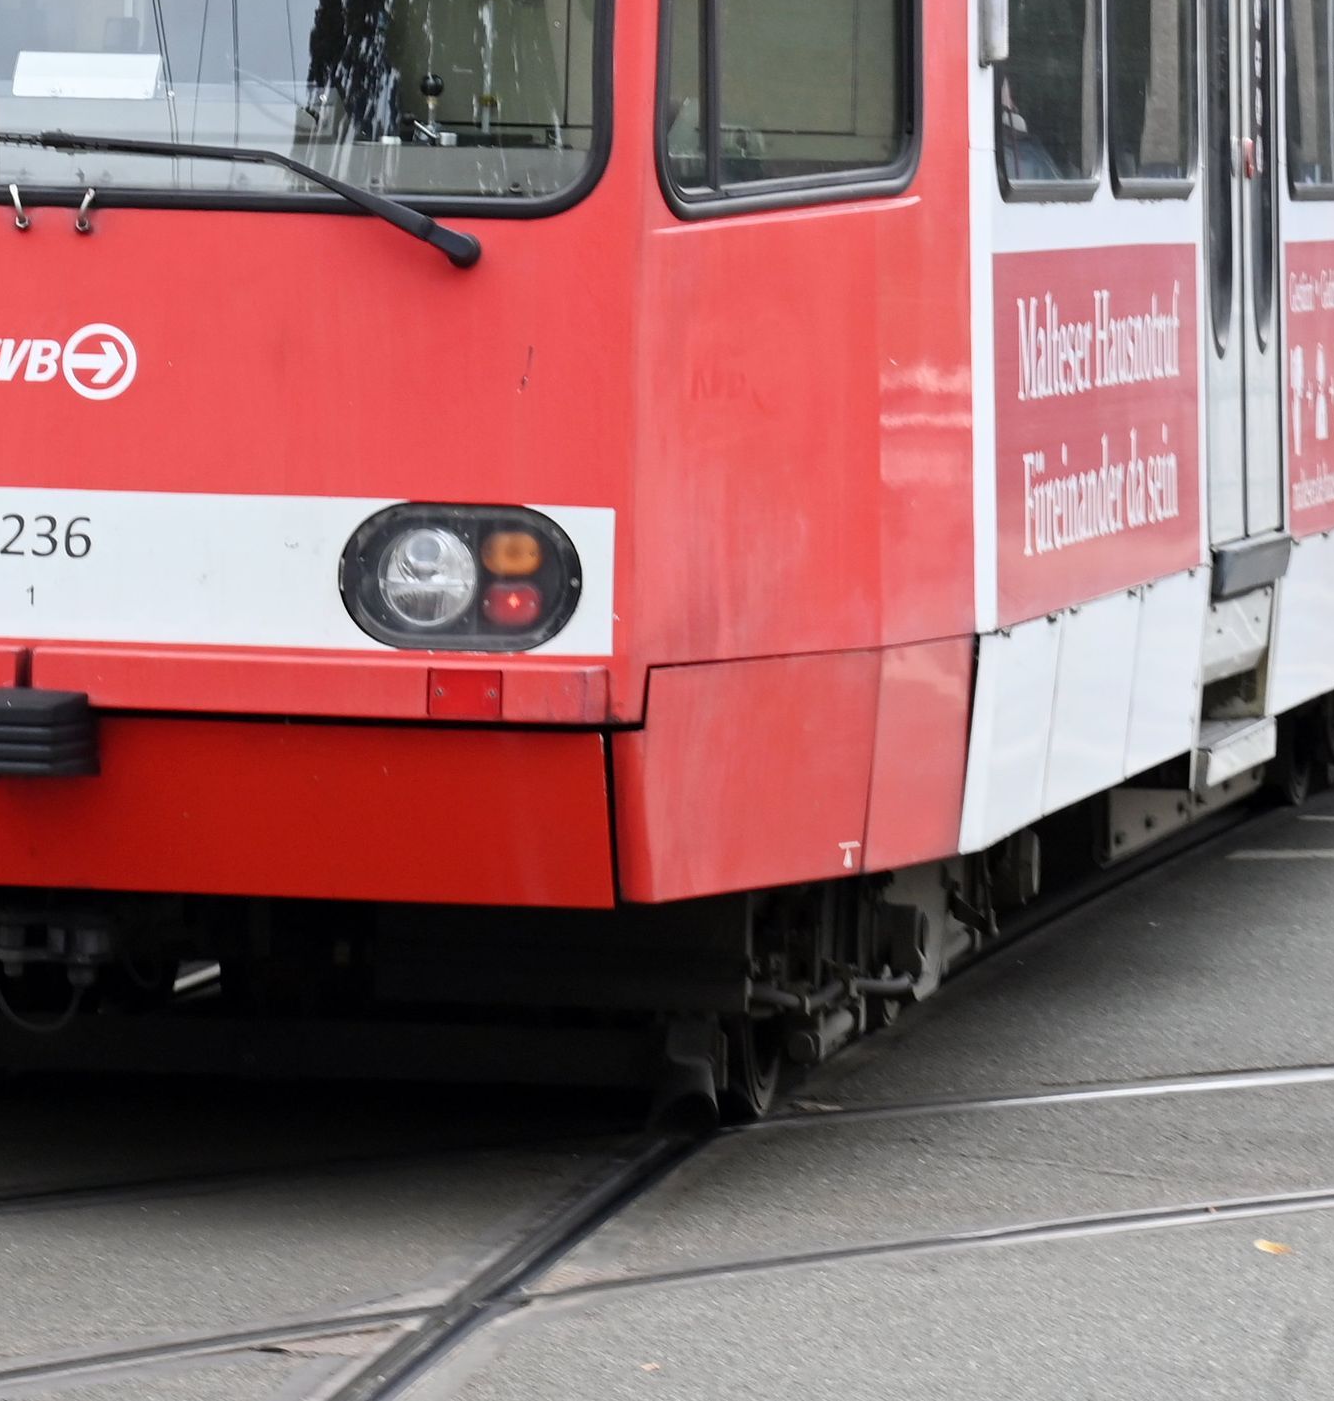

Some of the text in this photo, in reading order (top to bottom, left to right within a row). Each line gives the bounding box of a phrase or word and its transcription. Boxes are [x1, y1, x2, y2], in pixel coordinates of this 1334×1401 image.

[1017, 280, 1180, 401] Malteser Hausnotruf
[1023, 431, 1125, 557] Füreinander
[1126, 426, 1147, 528] da
[1147, 422, 1179, 524] sein
[26, 585, 35, 606] 1
